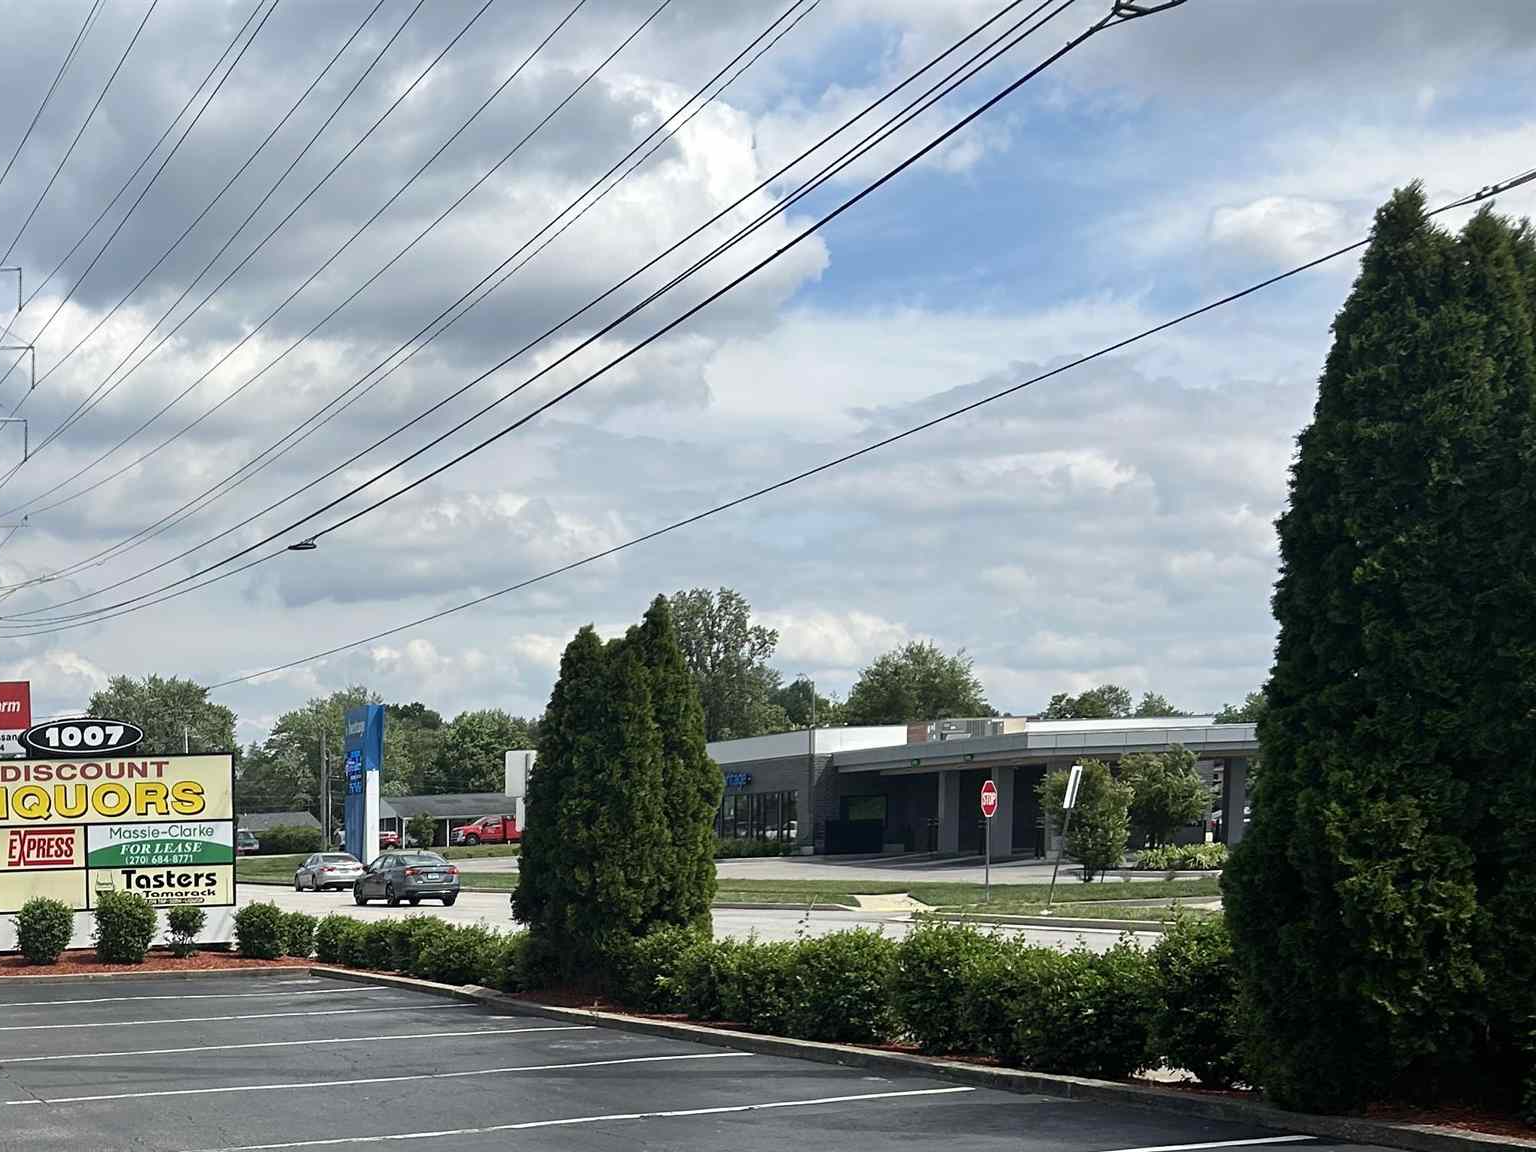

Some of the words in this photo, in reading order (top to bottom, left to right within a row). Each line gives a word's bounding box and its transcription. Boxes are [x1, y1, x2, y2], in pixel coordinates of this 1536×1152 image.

[45, 725, 124, 747] 1007
[0, 761, 170, 783] DISCOUNT
[983, 792, 996, 806] STOP
[109, 824, 215, 840] Massie-Clarke
[8, 829, 75, 867] EXPRESS
[120, 843, 150, 855] FOR
[154, 841, 203, 854] LEASE
[125, 855, 149, 865] (270)
[151, 854, 193, 865] 684-8771
[121, 869, 217, 890] Tasters
[143, 888, 216, 898] Tamarack
